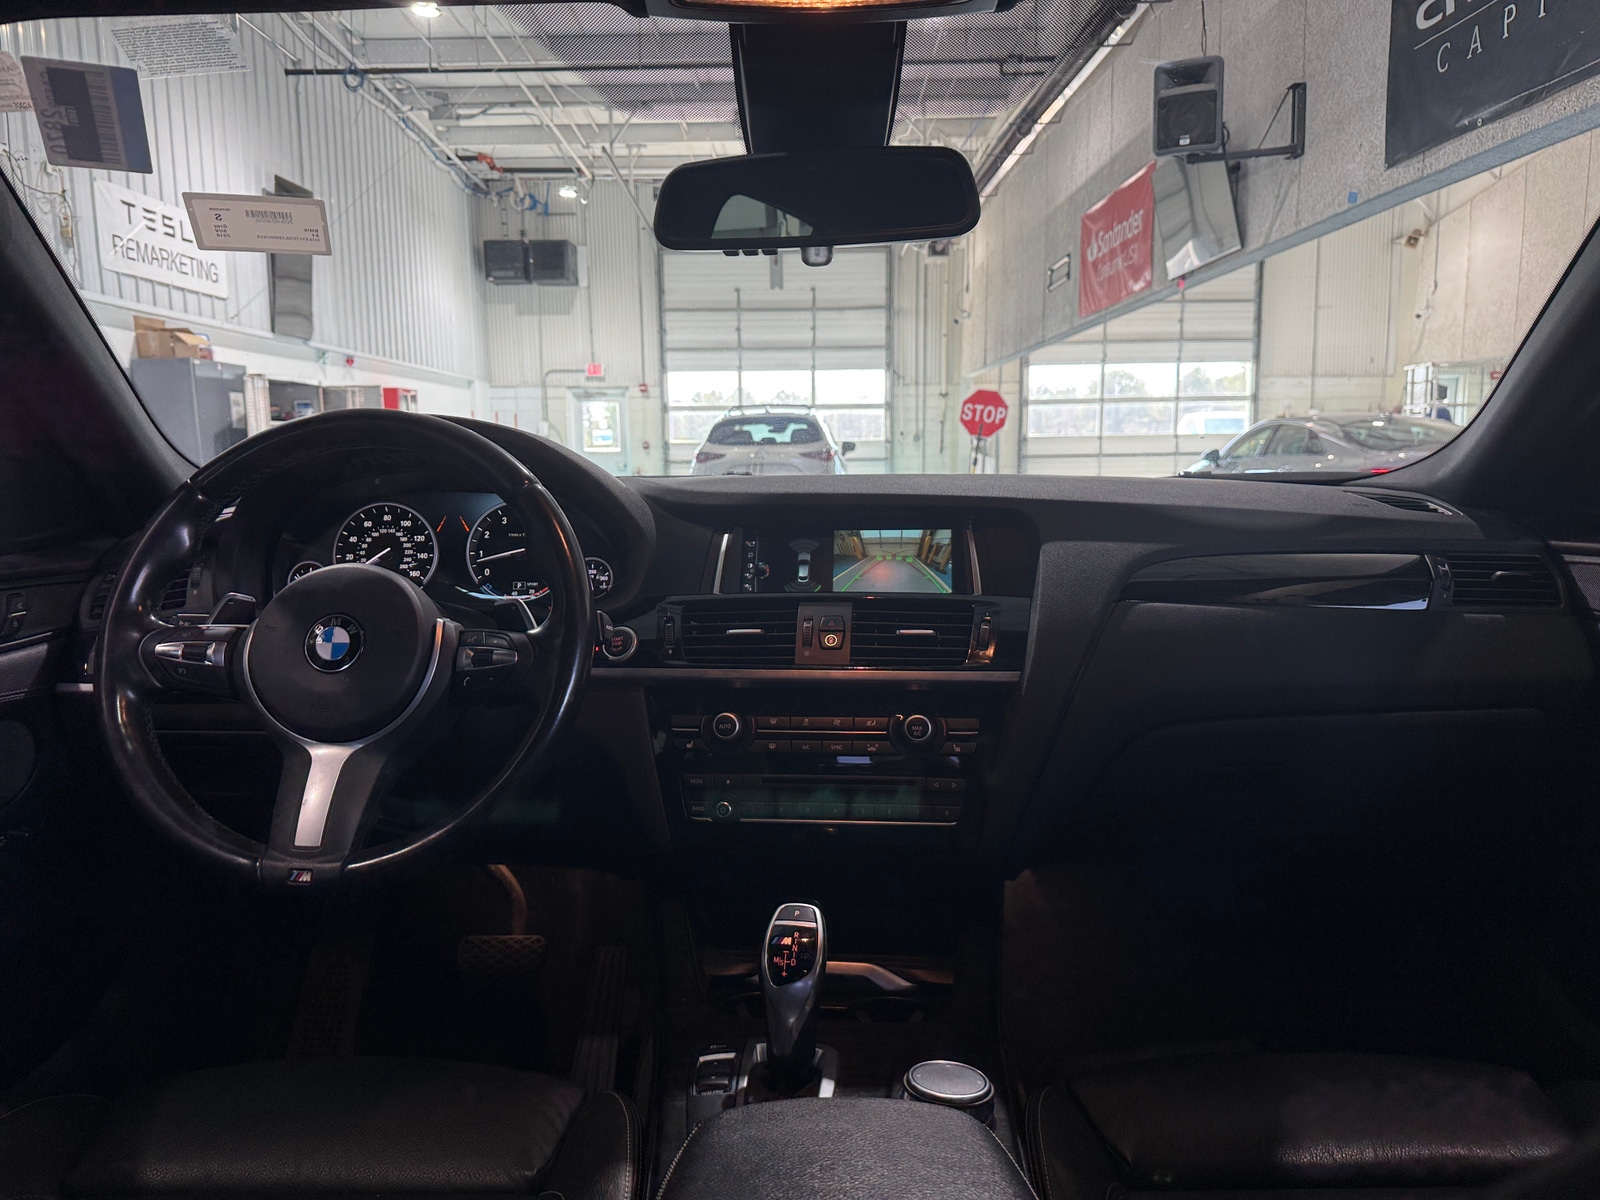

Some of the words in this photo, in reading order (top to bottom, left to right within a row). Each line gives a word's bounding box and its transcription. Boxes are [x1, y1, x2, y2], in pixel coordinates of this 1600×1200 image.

[120, 199, 195, 244] TESL
[1097, 209, 1144, 257] Santander
[112, 234, 219, 283] REMARKETING
[961, 402, 1007, 425] STOP
[484, 568, 490, 576] 0
[314, 617, 359, 635] BMW
[792, 944, 798, 952] N
[790, 958, 796, 966] D
